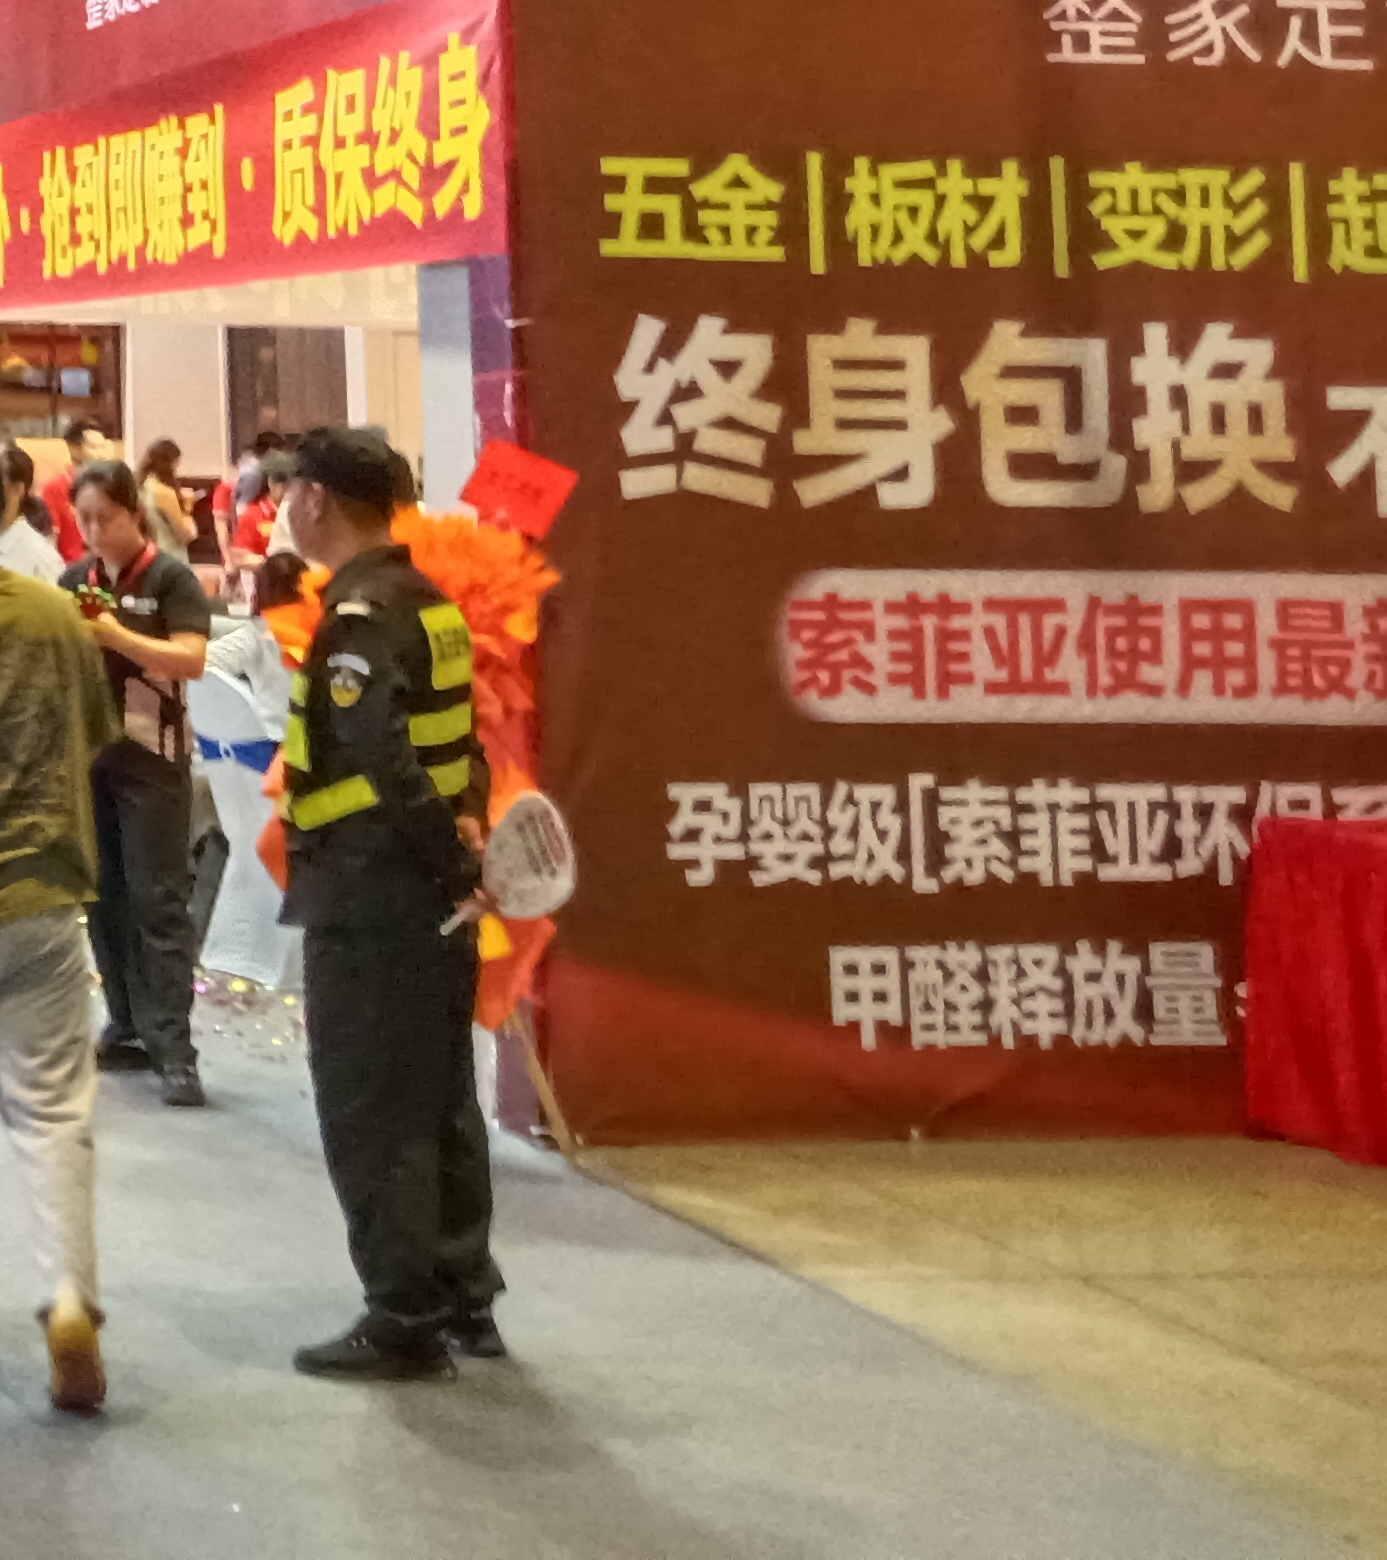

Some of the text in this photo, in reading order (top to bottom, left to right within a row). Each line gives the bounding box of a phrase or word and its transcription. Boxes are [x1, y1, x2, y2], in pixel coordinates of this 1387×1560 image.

[665, 773, 1387, 895] 孕婴级[索菲亚环
